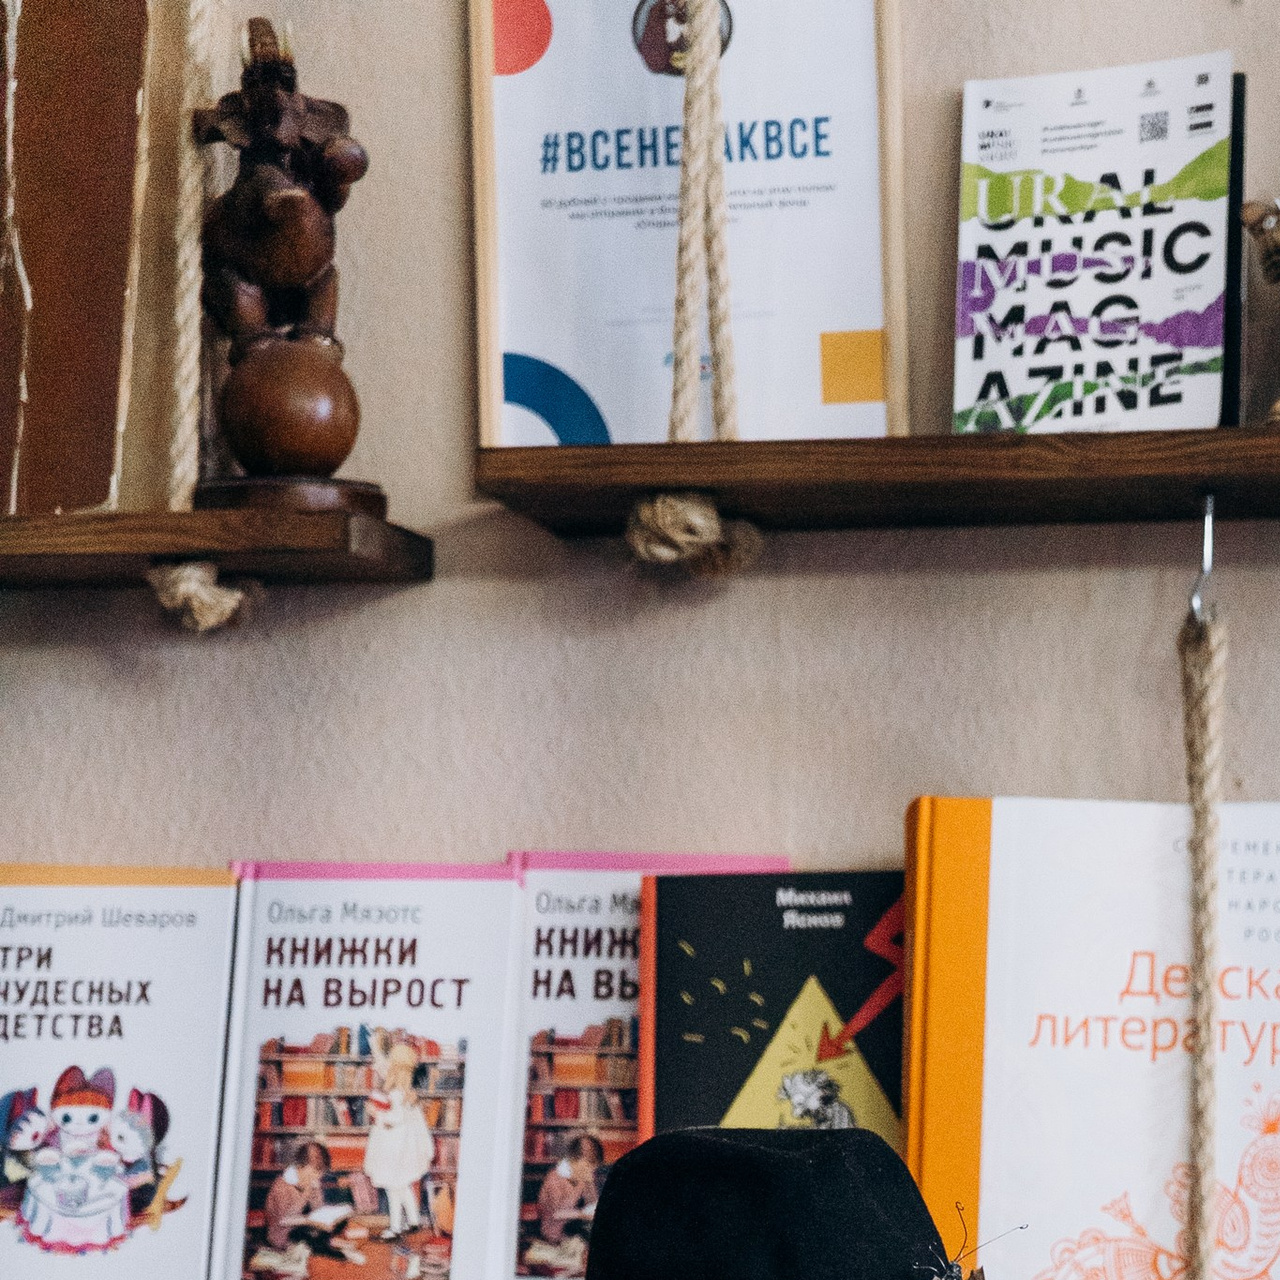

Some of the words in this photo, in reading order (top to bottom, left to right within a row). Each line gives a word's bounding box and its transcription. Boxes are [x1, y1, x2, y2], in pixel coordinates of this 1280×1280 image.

[540, 115, 831, 174] #ВСЕНЕАКВСЕ
[976, 169, 1174, 231] URAL
[975, 220, 1212, 292] MUSIC
[972, 294, 1140, 360] MAG
[964, 352, 1183, 433] AZINE
[0, 906, 94, 930] Дмитрий
[101, 905, 197, 930] Шеваров
[267, 901, 333, 924] Ольга
[536, 892, 600, 914] Ольга
[265, 936, 418, 967] КНИЖКИ
[263, 977, 305, 1008] НА
[323, 976, 470, 1009] ВЫРОСТ
[533, 968, 576, 999] НА
